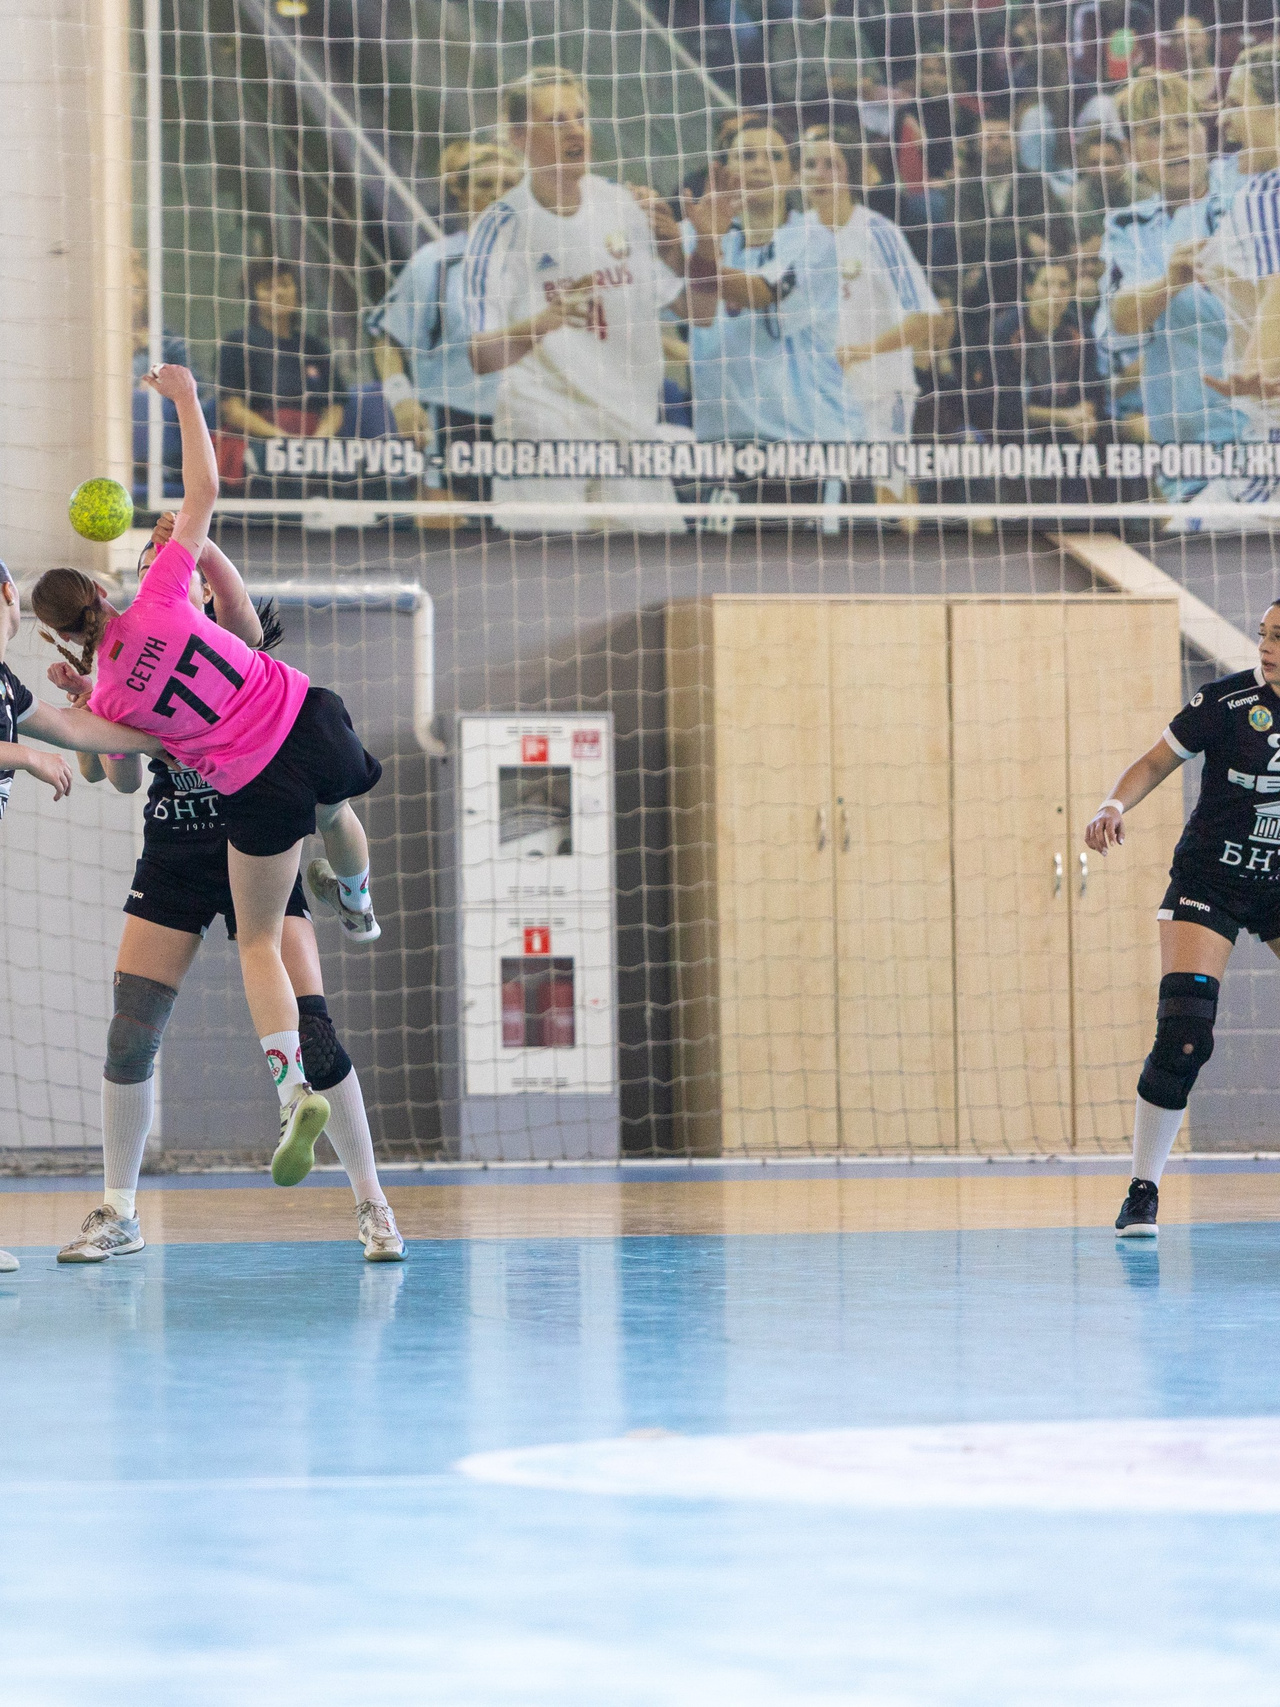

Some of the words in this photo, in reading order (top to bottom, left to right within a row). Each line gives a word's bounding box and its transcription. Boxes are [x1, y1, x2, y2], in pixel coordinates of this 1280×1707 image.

[266, 440, 423, 474] БЕЛАРУСЬ
[452, 441, 624, 475] СЛОВАКИЯ.
[633, 442, 889, 480] КВАЛИФИКАЦИЯ
[897, 444, 1100, 478] ЧЕМПИОНАТА
[1246, 445, 1280, 478] Ж
[126, 636, 167, 692] СЕТУН
[152, 633, 246, 725] 77
[1227, 694, 1260, 710] Kempa
[1227, 768, 1280, 794] BE
[1219, 840, 1280, 872] БН
[1179, 896, 1211, 913] Kempa
